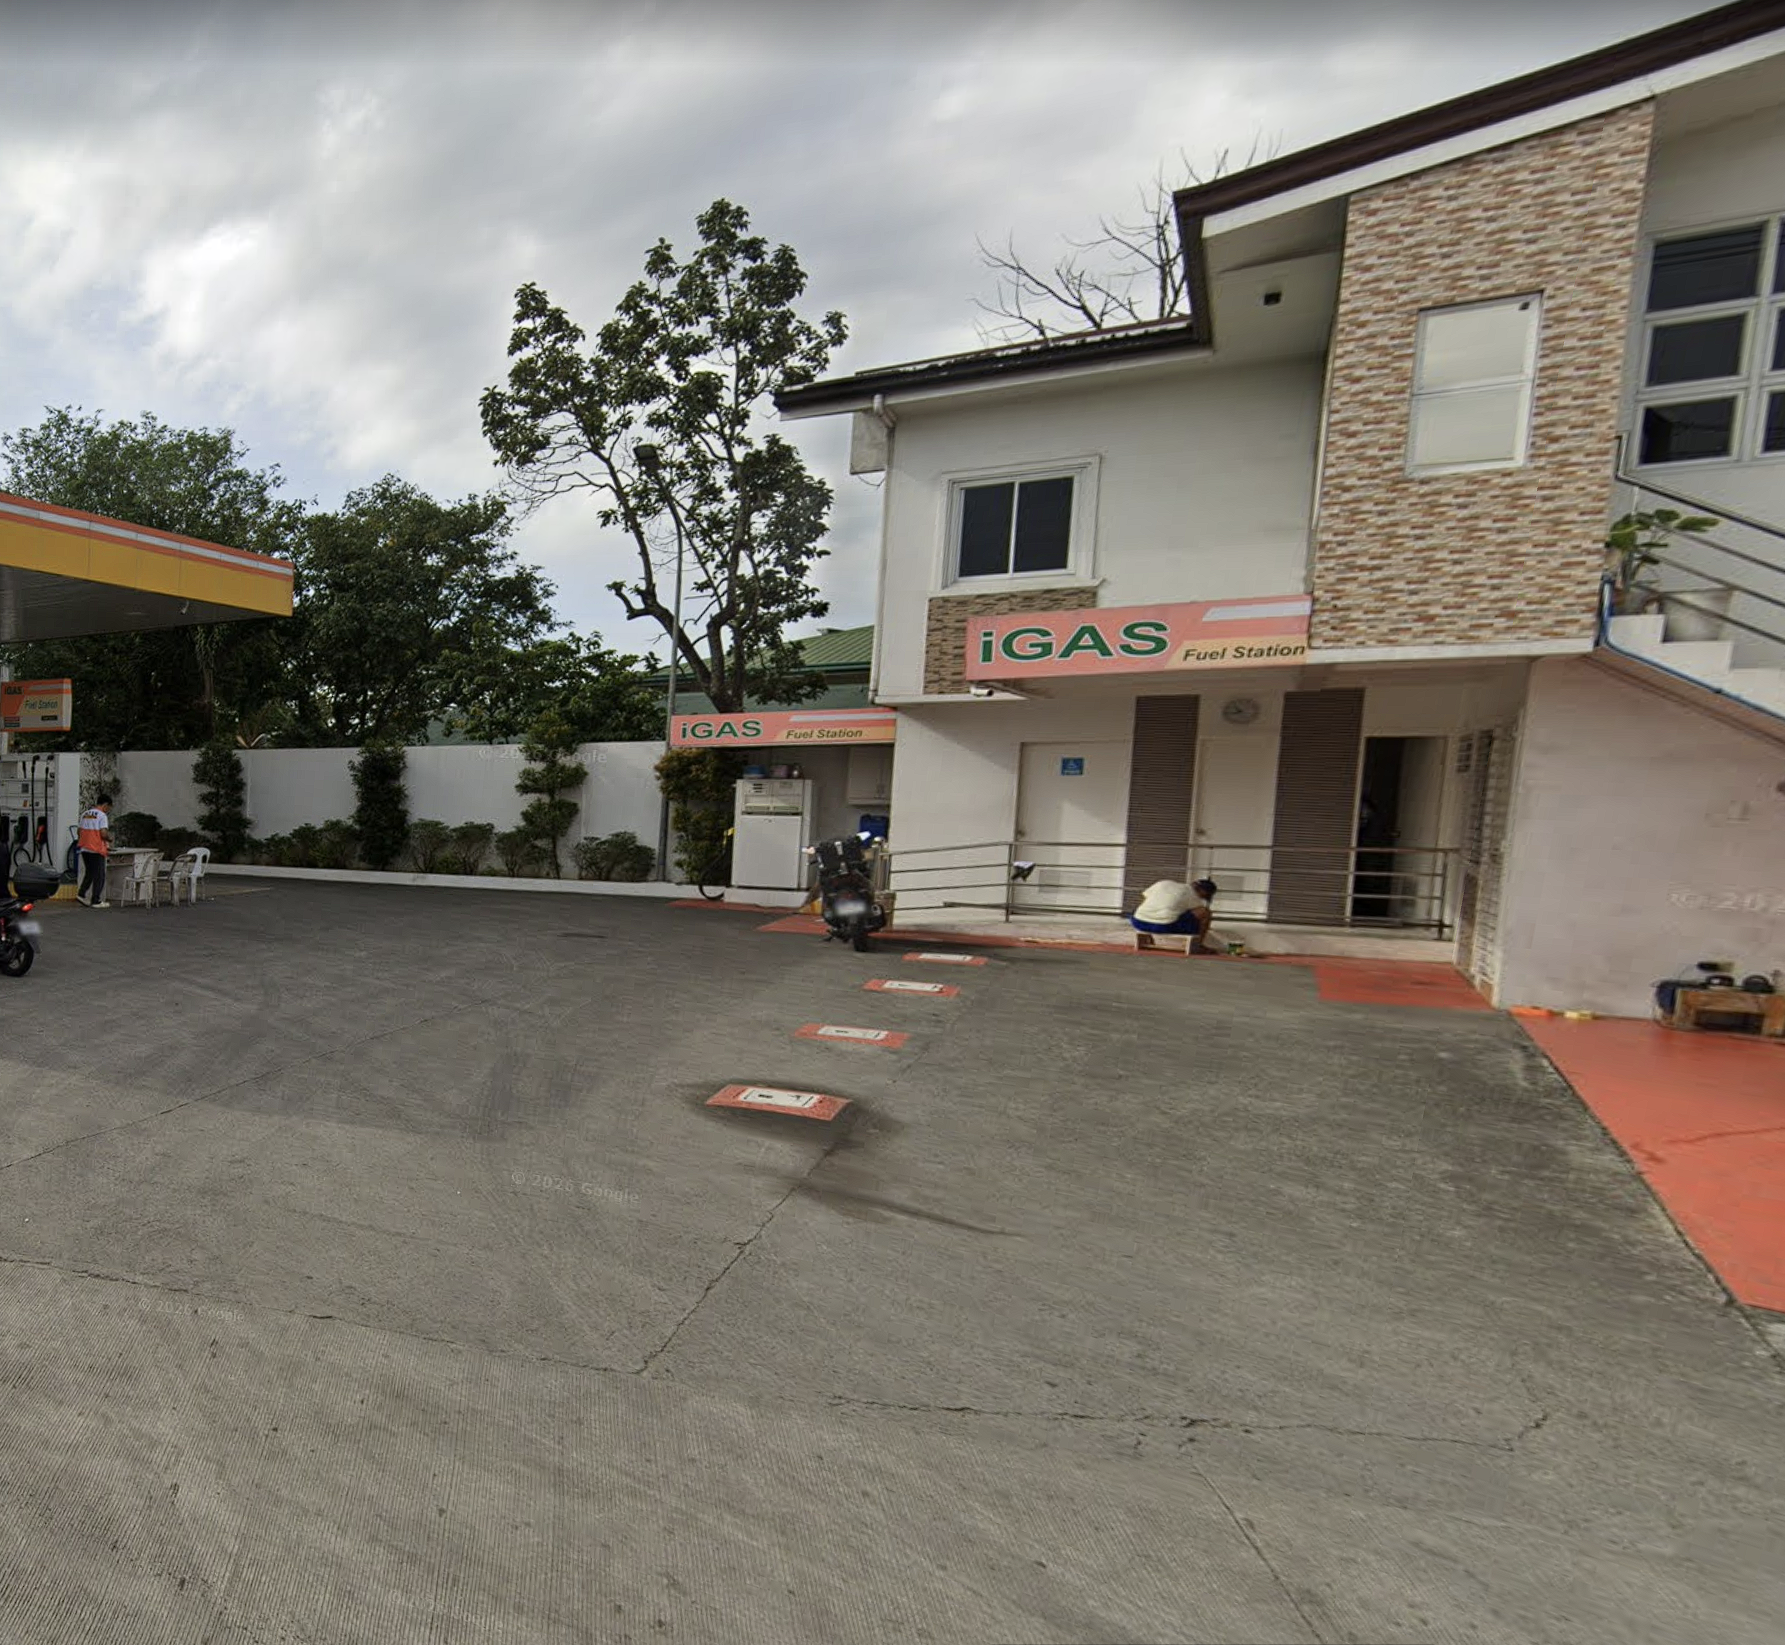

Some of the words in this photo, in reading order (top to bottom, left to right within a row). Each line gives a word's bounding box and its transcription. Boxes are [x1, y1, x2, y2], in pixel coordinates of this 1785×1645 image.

[979, 620, 1170, 665] iGAS
[1181, 645, 1226, 662] Fuel
[1232, 643, 1306, 660] Station
[680, 720, 763, 740] iGAS
[785, 729, 814, 740] Fuel
[816, 729, 863, 739] Station
